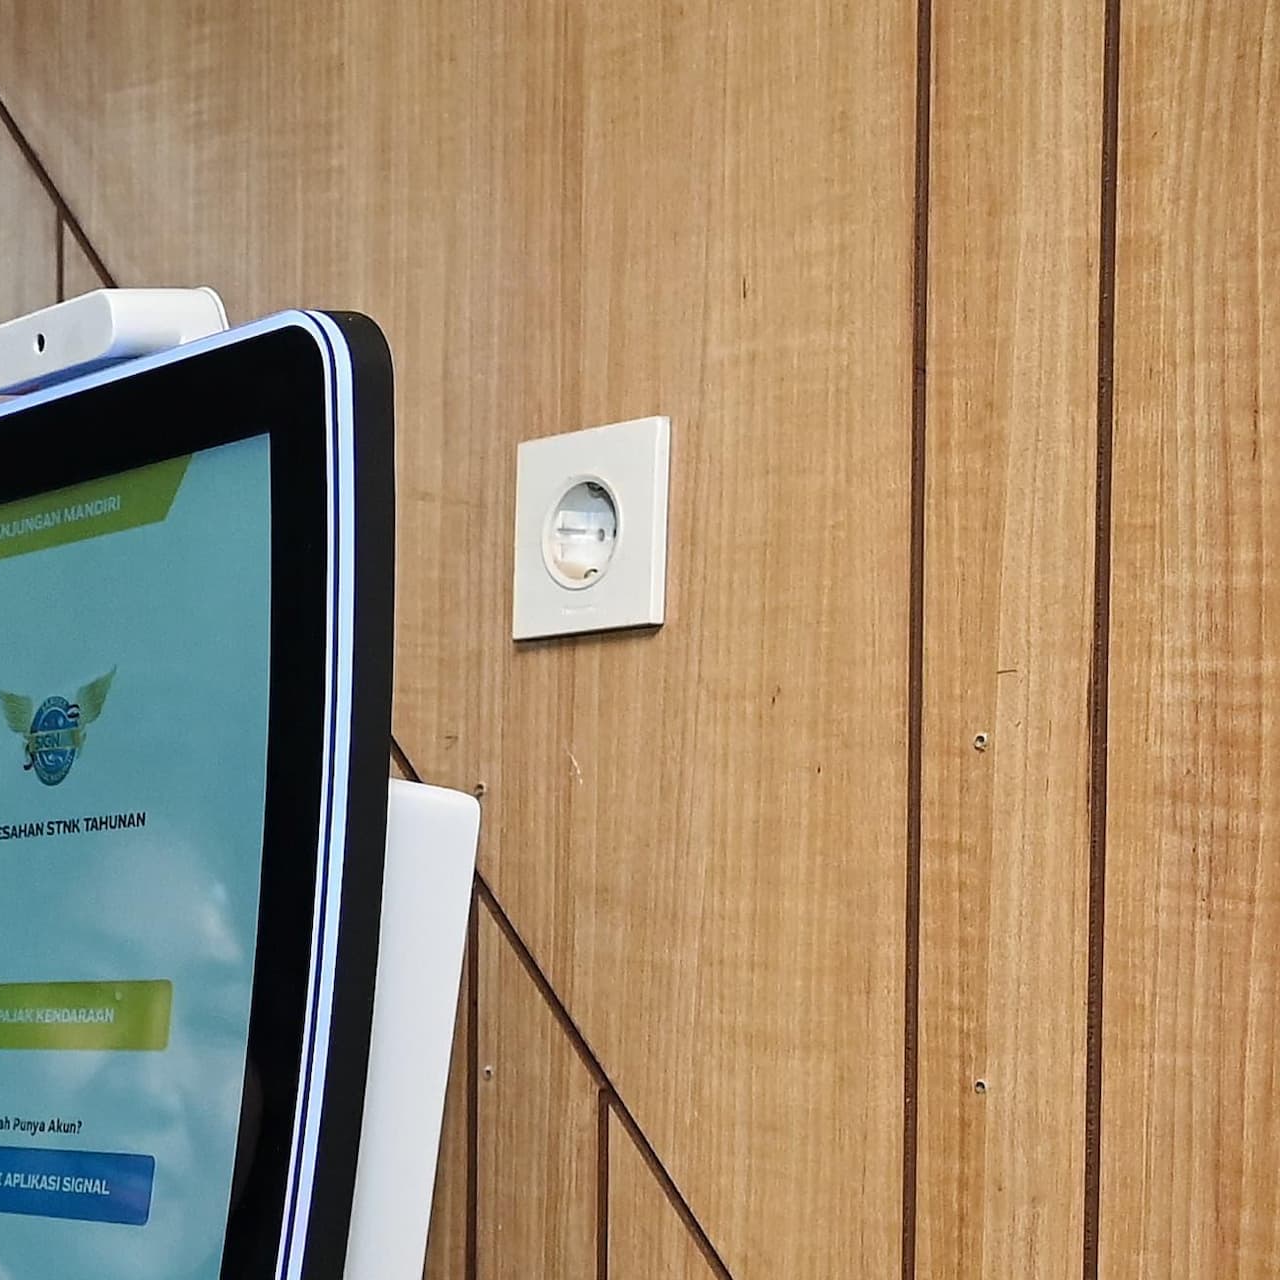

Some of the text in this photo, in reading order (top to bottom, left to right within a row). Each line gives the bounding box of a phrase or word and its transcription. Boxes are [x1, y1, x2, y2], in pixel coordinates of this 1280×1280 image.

[63, 495, 121, 522] MANDIRI
[46, 818, 81, 836] STNK
[83, 811, 146, 833] TAHUNAN
[35, 1007, 115, 1023] KENDARAAN
[12, 1117, 46, 1136] Punya
[47, 1118, 83, 1134] Akun?
[3, 1172, 61, 1192] APLIKASI
[61, 1176, 111, 1196] SIGNAL
